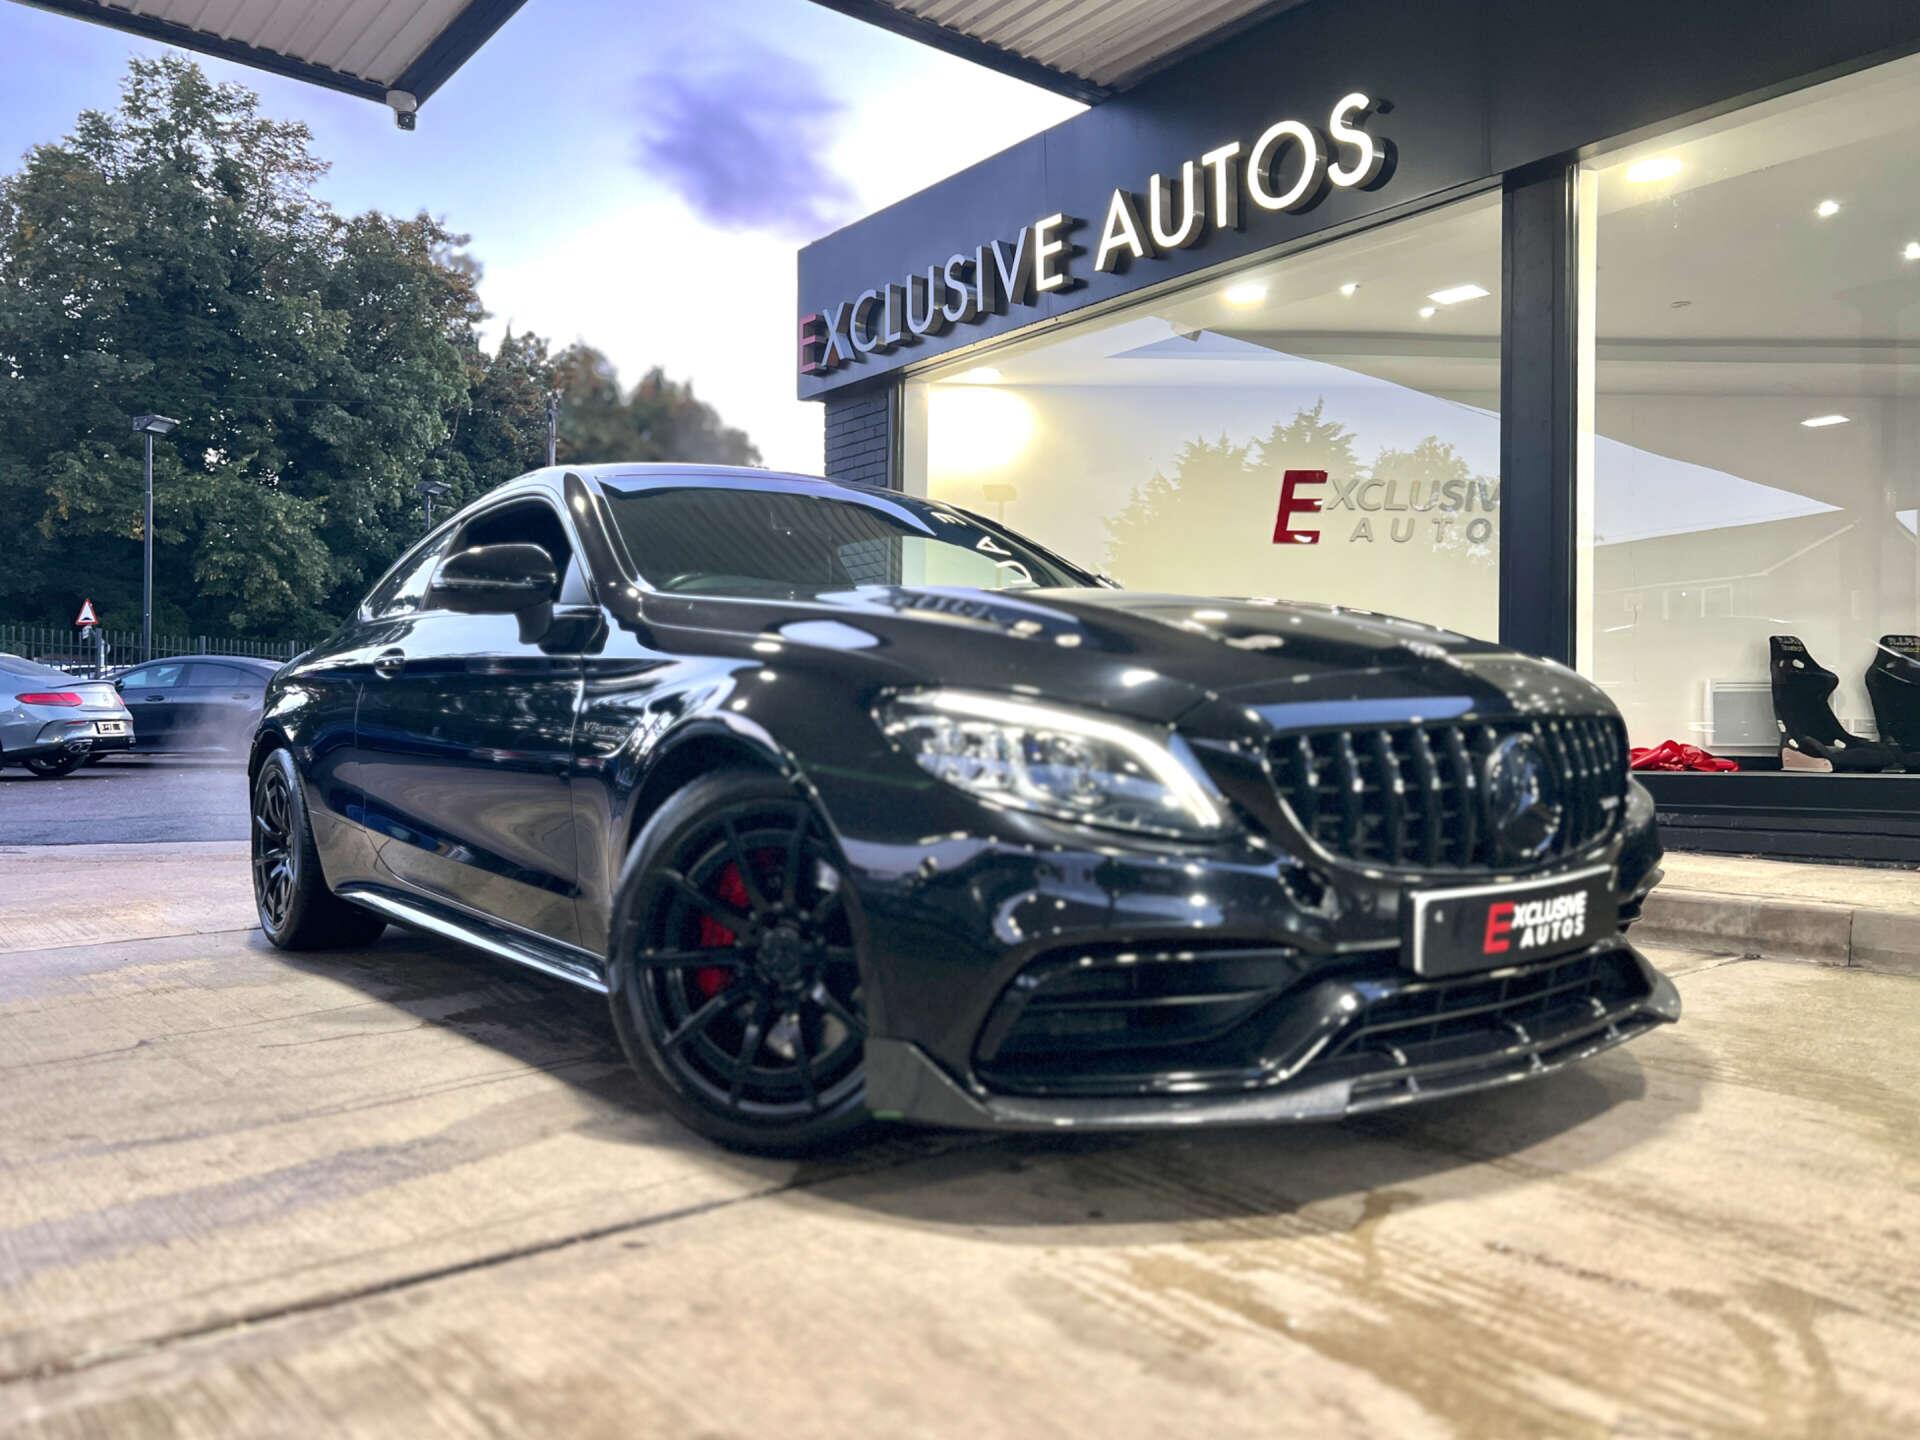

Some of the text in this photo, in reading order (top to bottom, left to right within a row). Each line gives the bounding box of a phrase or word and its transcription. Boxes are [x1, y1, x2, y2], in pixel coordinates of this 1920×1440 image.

[800, 92, 1378, 374] EXCLUSIVE AUTOS
[1272, 469, 1499, 544] EXCLUSIV
[1349, 517, 1493, 544] AUTO
[1483, 890, 1588, 955] EXCLUSIVE
[1519, 914, 1585, 950] AUTOS
